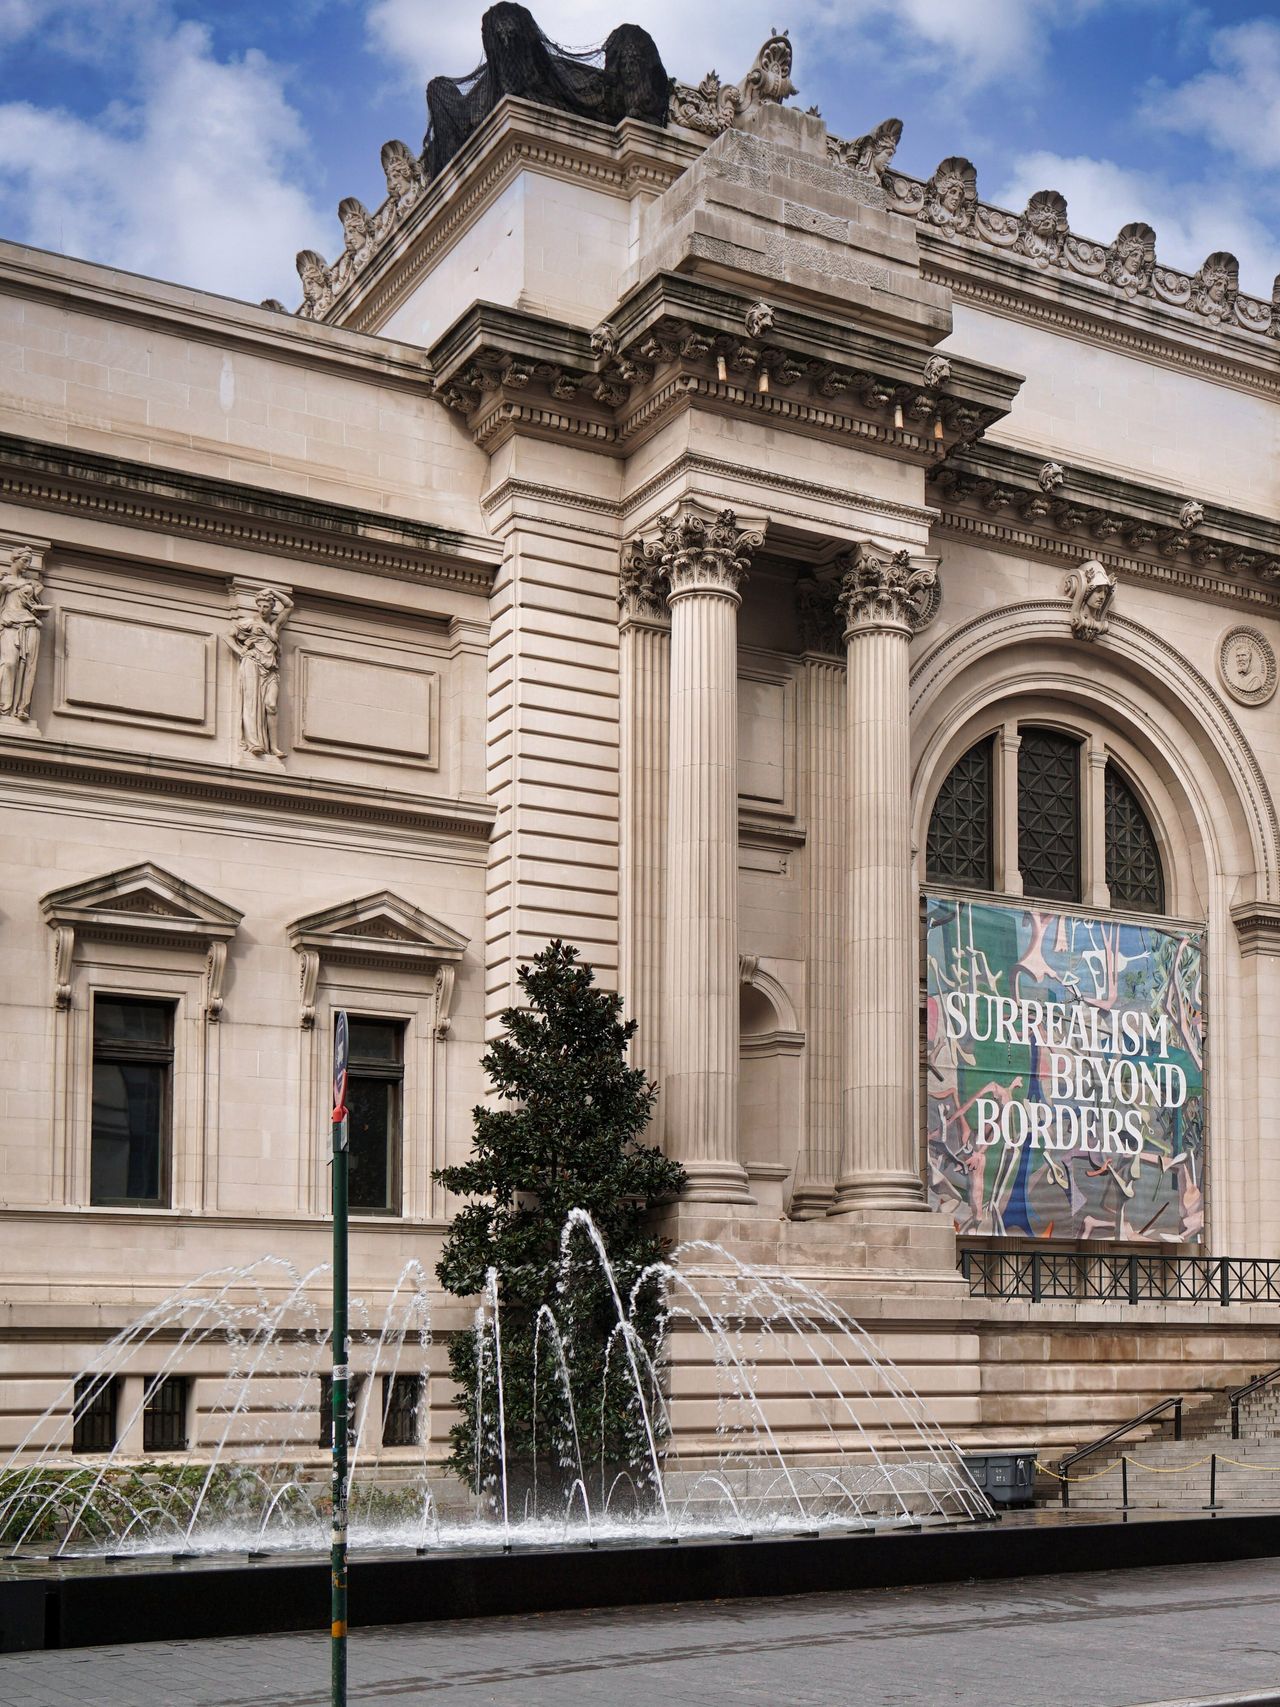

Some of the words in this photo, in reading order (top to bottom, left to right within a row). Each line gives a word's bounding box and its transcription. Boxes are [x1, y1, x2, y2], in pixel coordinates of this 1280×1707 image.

[946, 991, 1169, 1059] SURREALISM
[1050, 1053, 1187, 1109] BEYOND
[975, 1098, 1144, 1155] BORDERS
